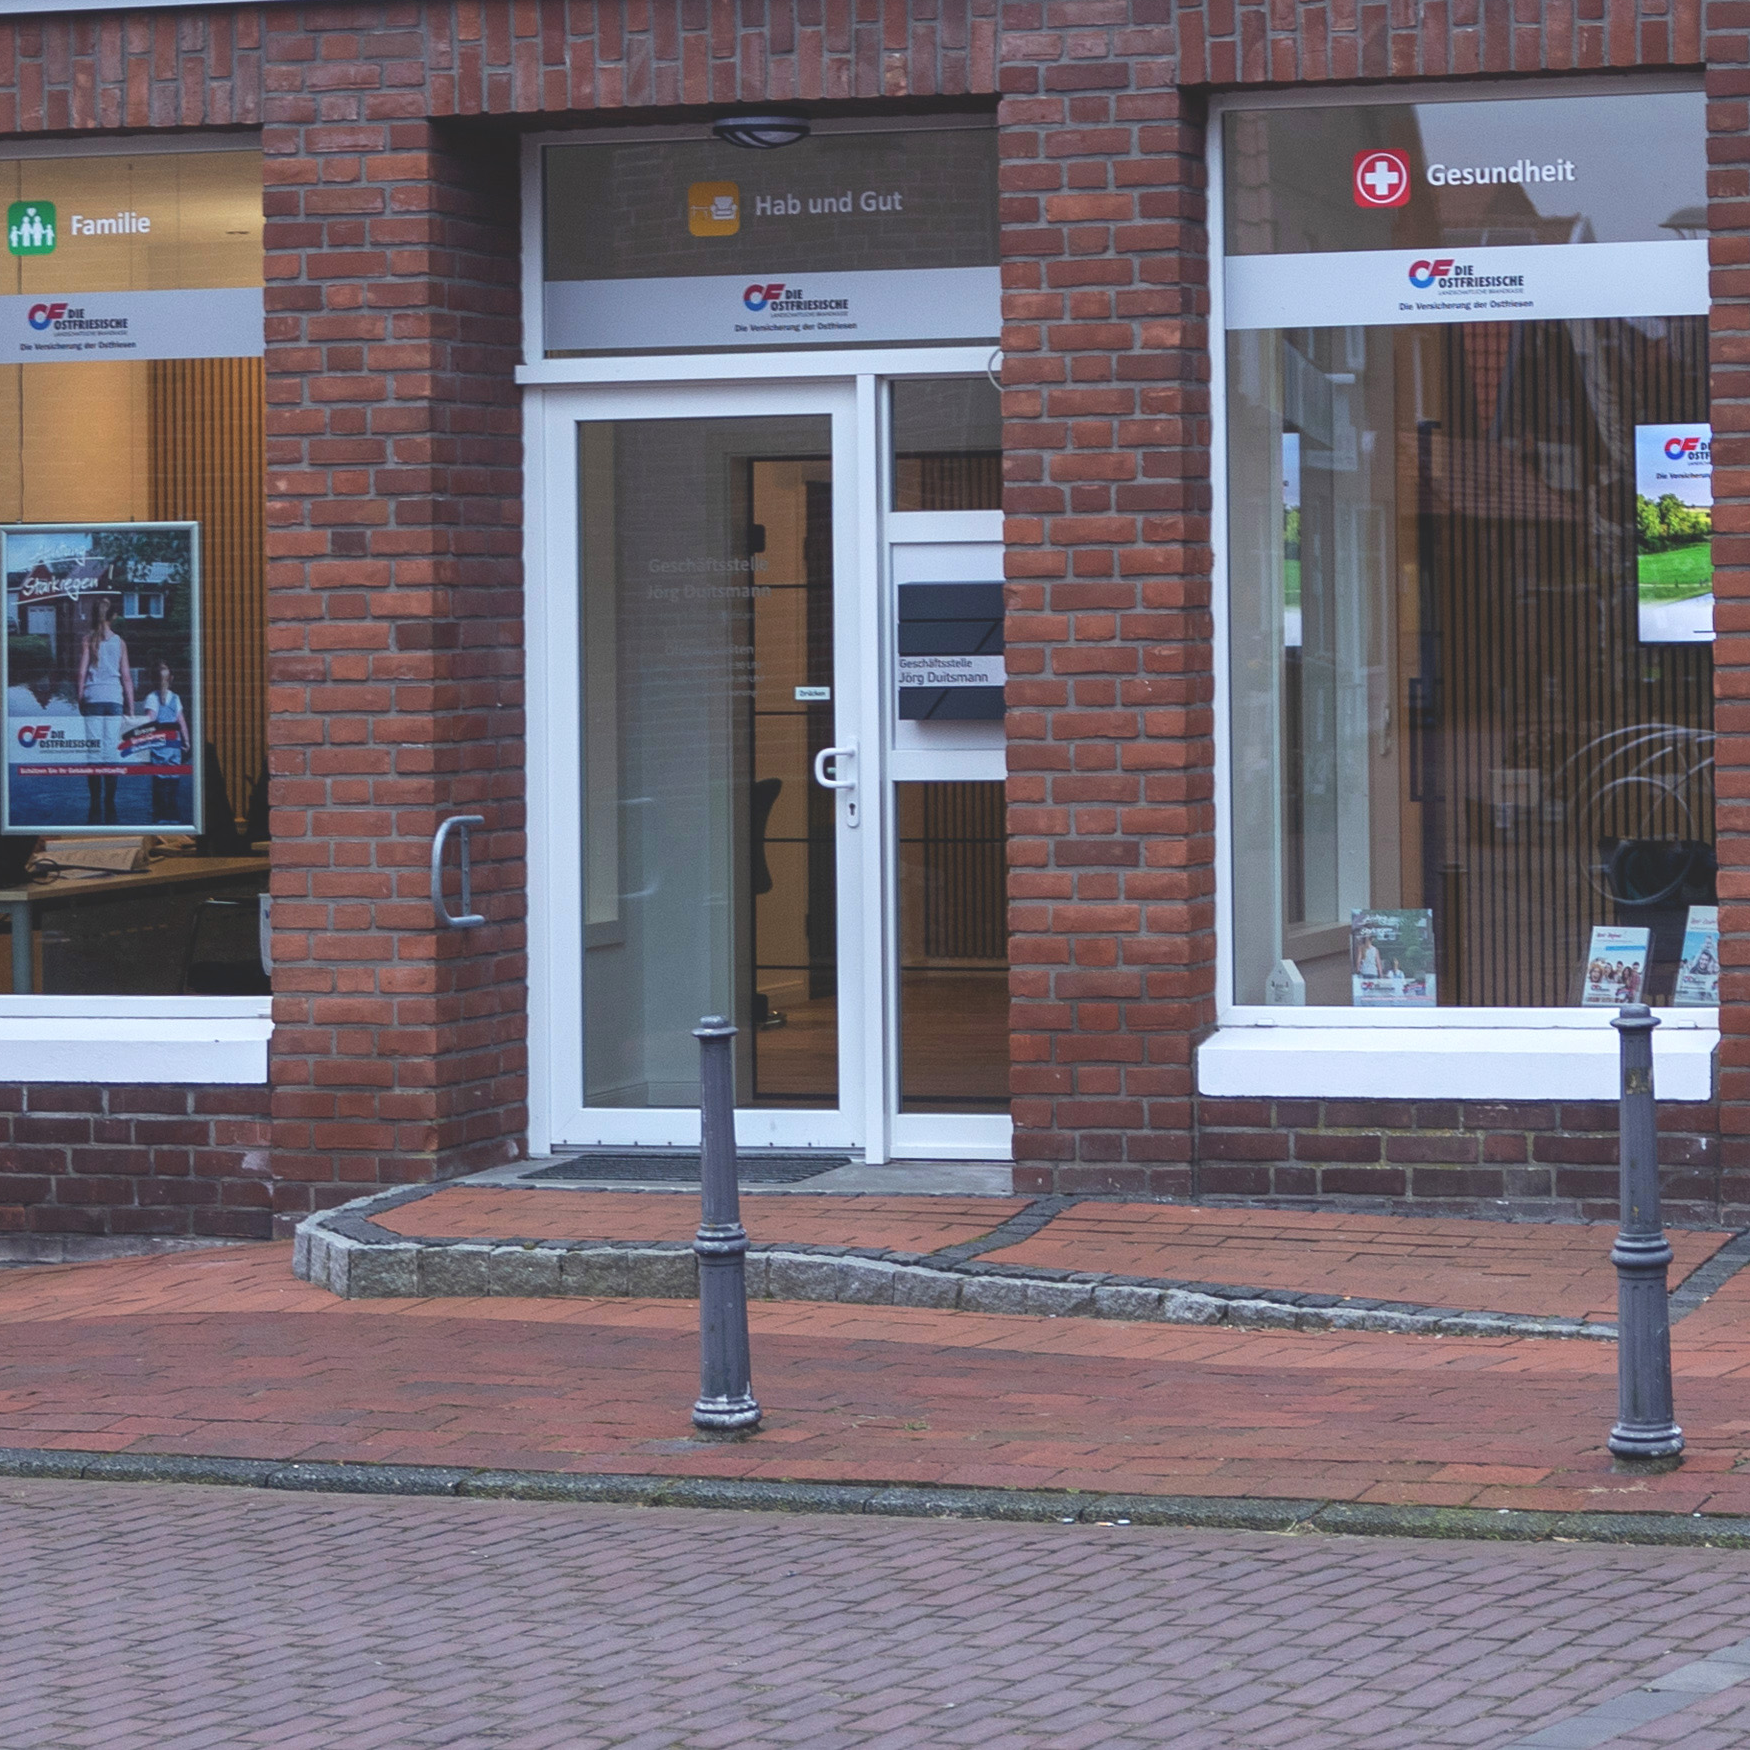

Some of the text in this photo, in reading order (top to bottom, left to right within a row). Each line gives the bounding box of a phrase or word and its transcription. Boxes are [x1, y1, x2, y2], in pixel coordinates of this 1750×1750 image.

[1427, 160, 1575, 186] Gesundheit
[756, 190, 903, 216] Hab und Gut
[71, 212, 150, 235] Familie
[1455, 266, 1474, 275] DIE
[1438, 276, 1524, 288] OSTFRIESISCHE
[785, 289, 803, 299] DIE
[770, 299, 848, 311] OSTFRIESISCHE
[1416, 302, 1471, 310] Versicherung
[1490, 300, 1534, 308] Ostfriesen
[68, 309, 85, 318] DIE
[54, 319, 128, 330] OSTFRIESISCHE
[22, 576, 98, 601] Starkregen
[900, 658, 972, 668] Geschäftsstelle
[899, 672, 988, 685] Jörg Duitsmann
[39, 740, 100, 748] OSTFRIESISCHE
